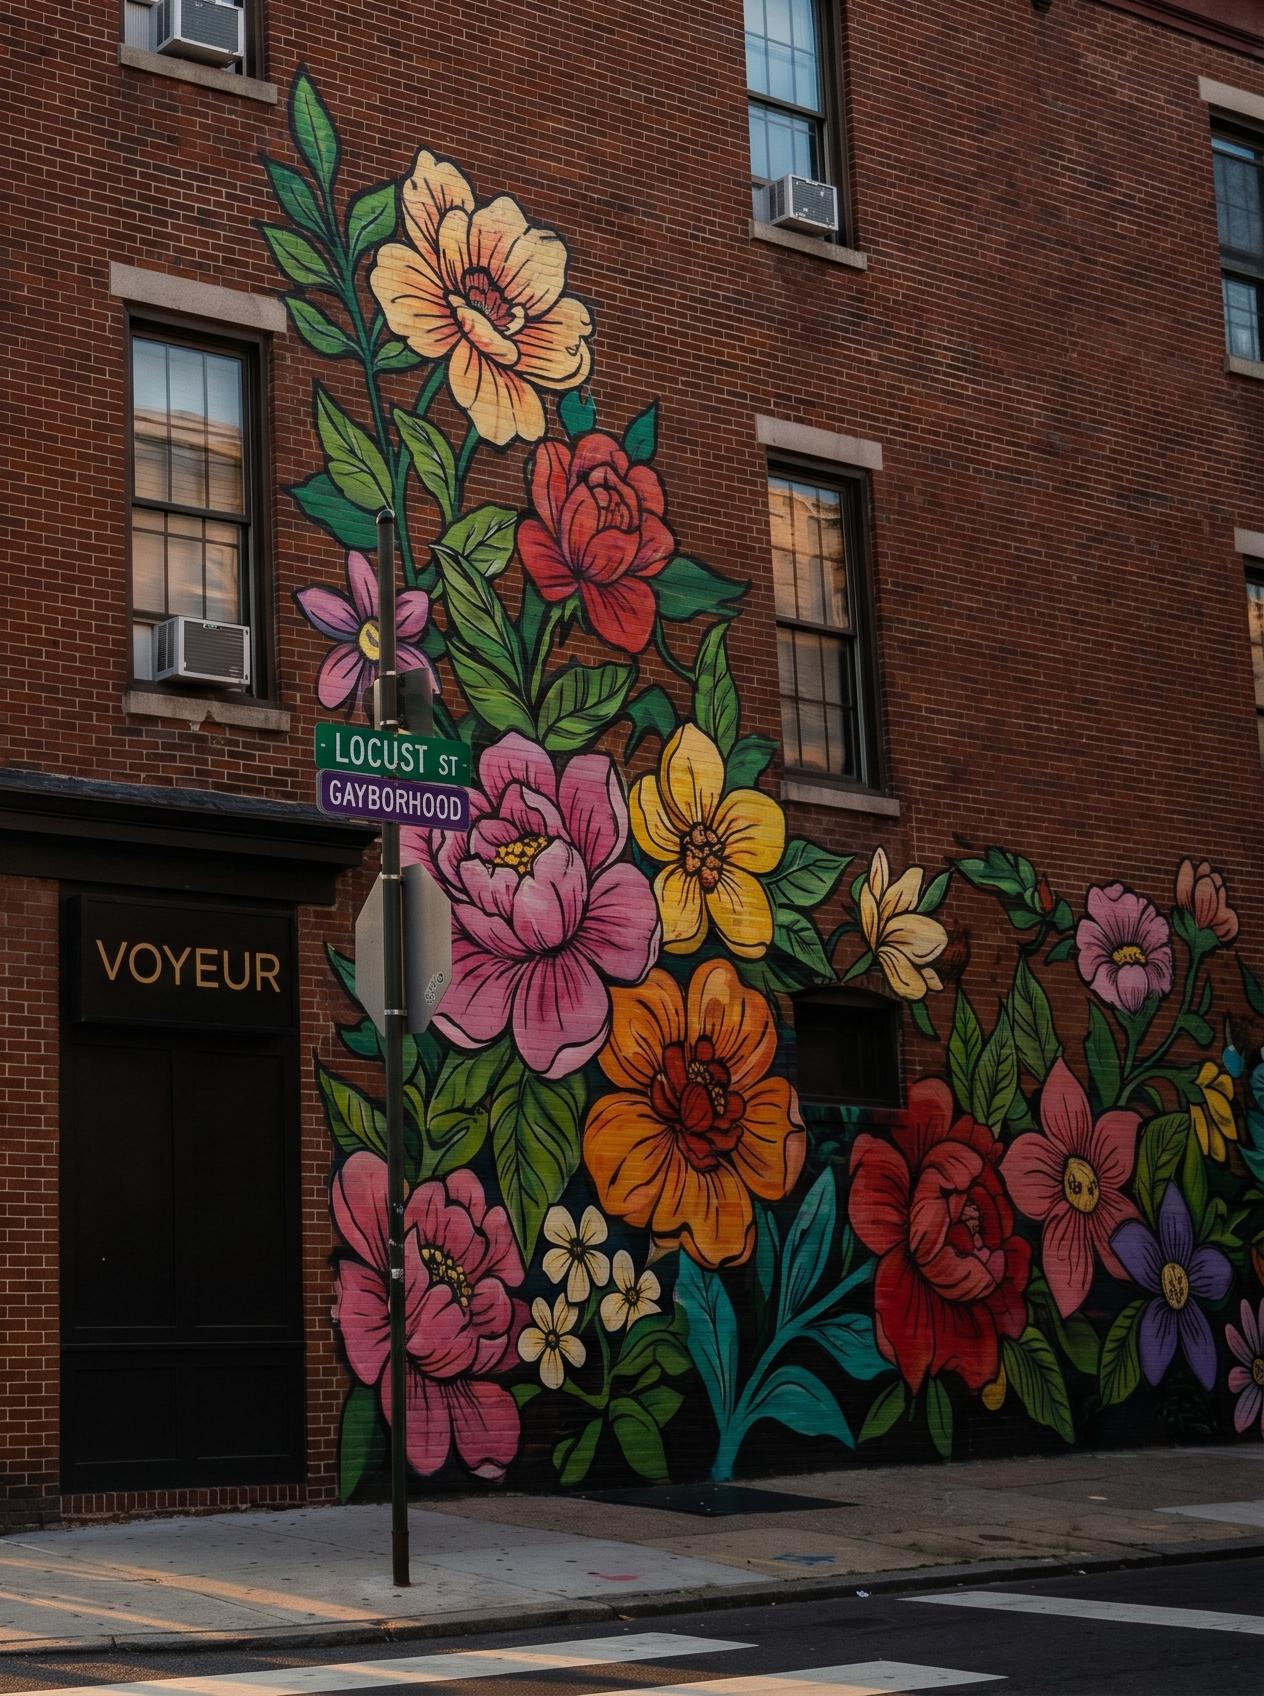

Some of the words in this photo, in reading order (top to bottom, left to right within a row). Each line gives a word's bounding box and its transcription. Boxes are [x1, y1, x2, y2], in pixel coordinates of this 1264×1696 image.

[335, 732, 428, 774] LOCUST
[438, 755, 459, 776] ST
[329, 779, 462, 821] GAYBORHOOD
[95, 939, 281, 993] VOYEUR
